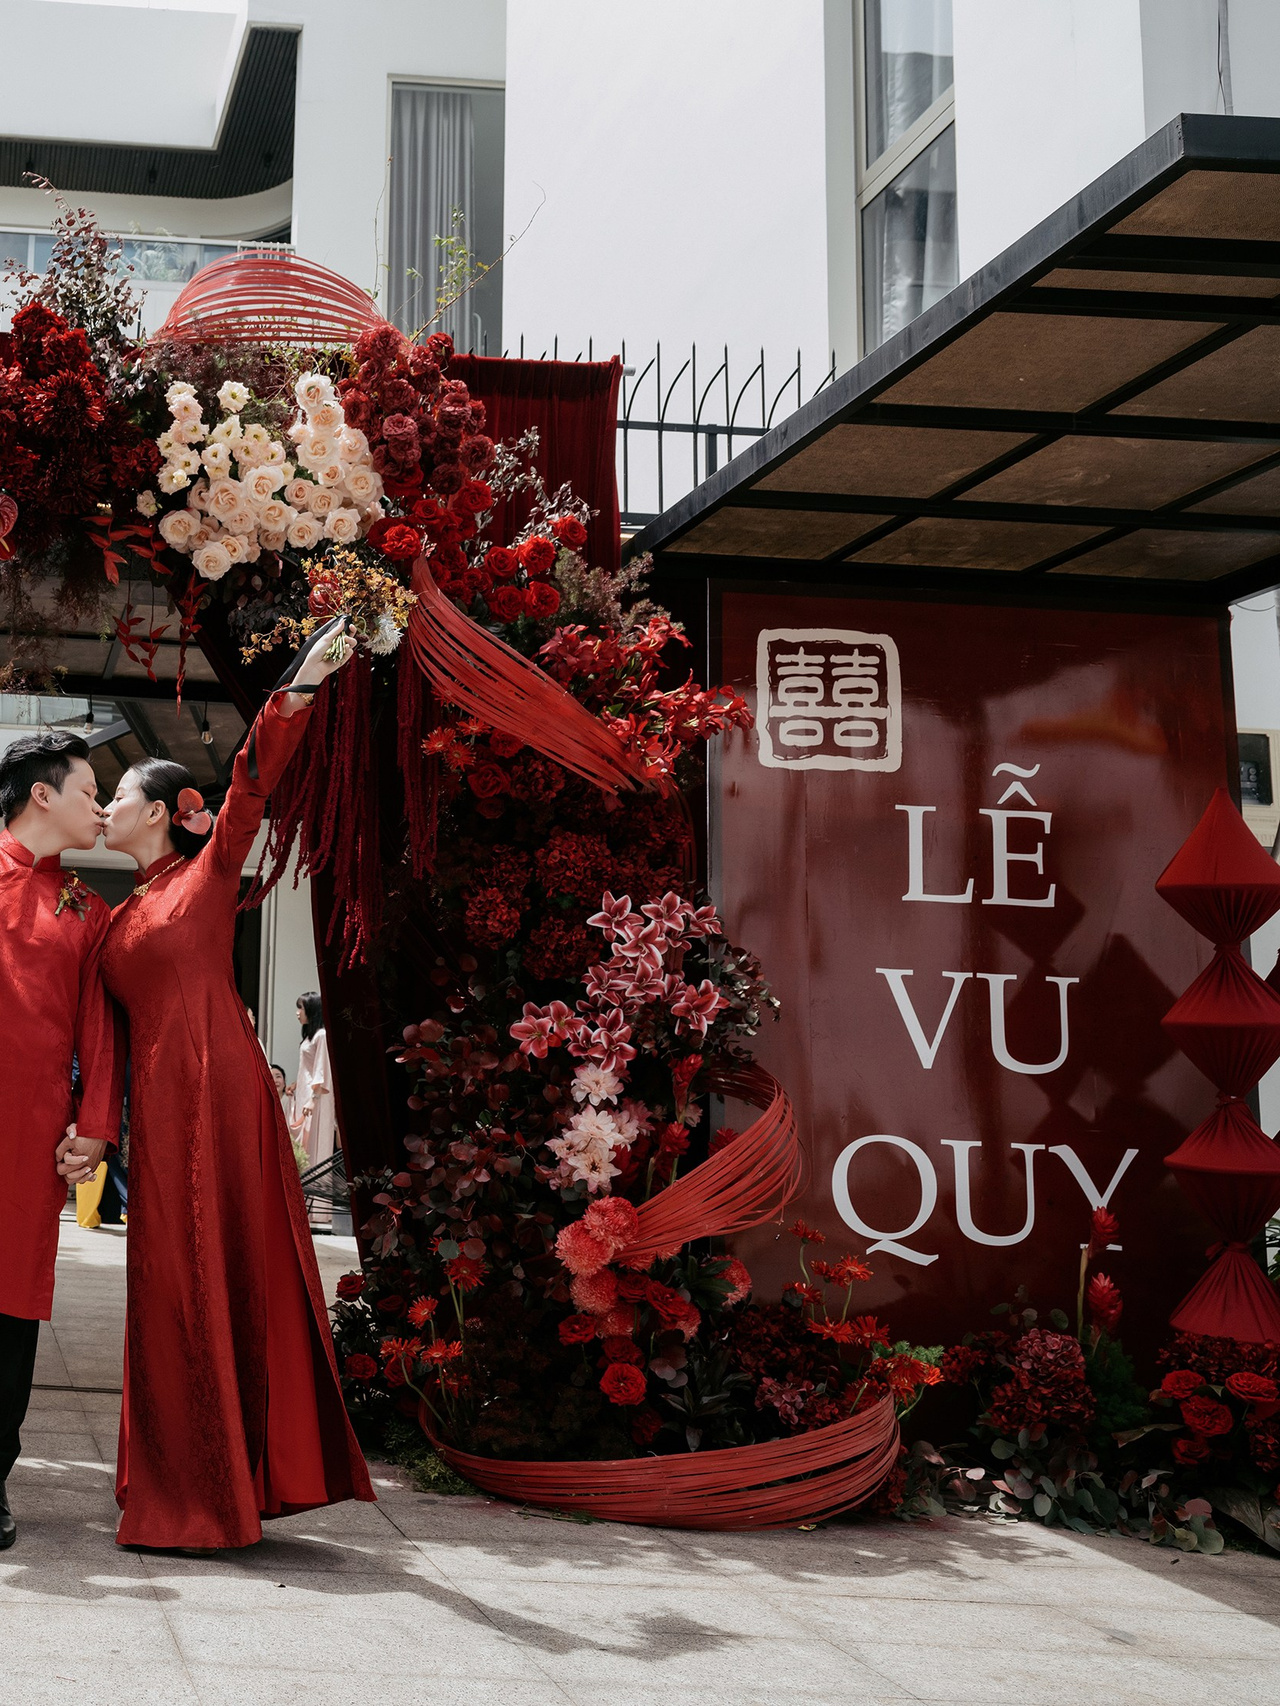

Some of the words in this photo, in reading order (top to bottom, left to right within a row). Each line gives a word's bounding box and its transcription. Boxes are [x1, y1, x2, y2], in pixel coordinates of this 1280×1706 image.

[895, 763, 1056, 907] LỄ
[875, 968, 1079, 1074] VU
[832, 1134, 1139, 1266] QUY
